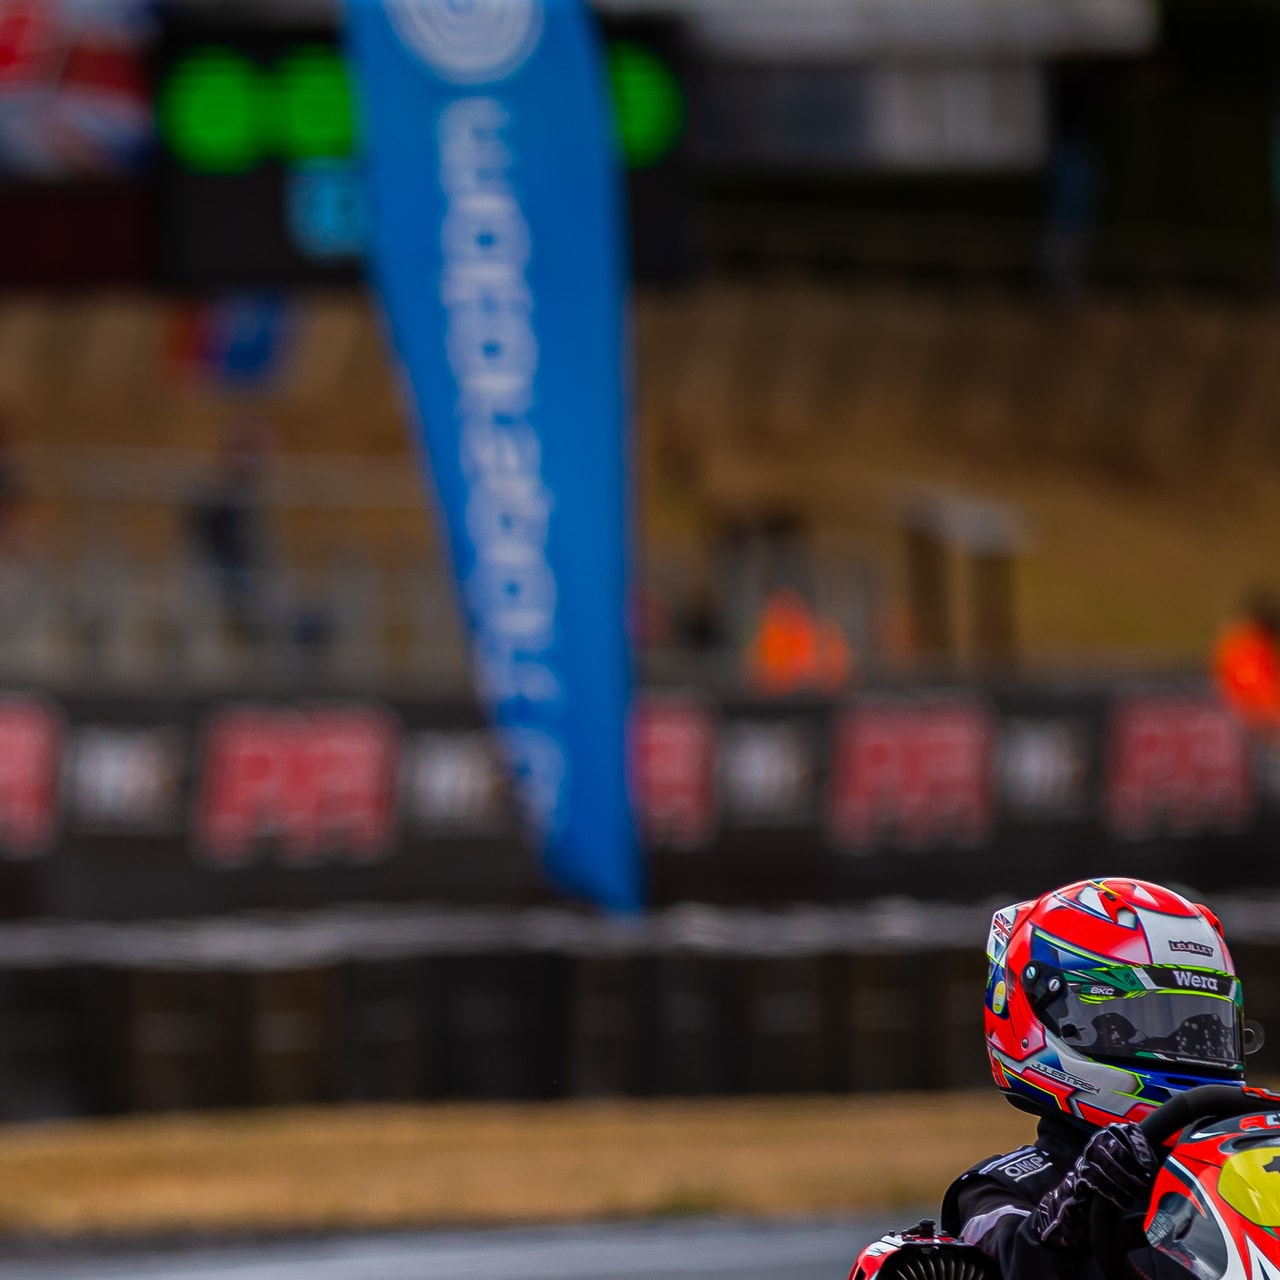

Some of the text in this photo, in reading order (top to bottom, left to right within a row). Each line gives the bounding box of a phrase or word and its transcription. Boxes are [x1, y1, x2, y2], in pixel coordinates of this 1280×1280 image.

[1090, 986, 1115, 996] BKC
[1172, 970, 1218, 991] Wera
[1031, 1062, 1102, 1096] JULES NASH
[1004, 1156, 1044, 1177] OMP
